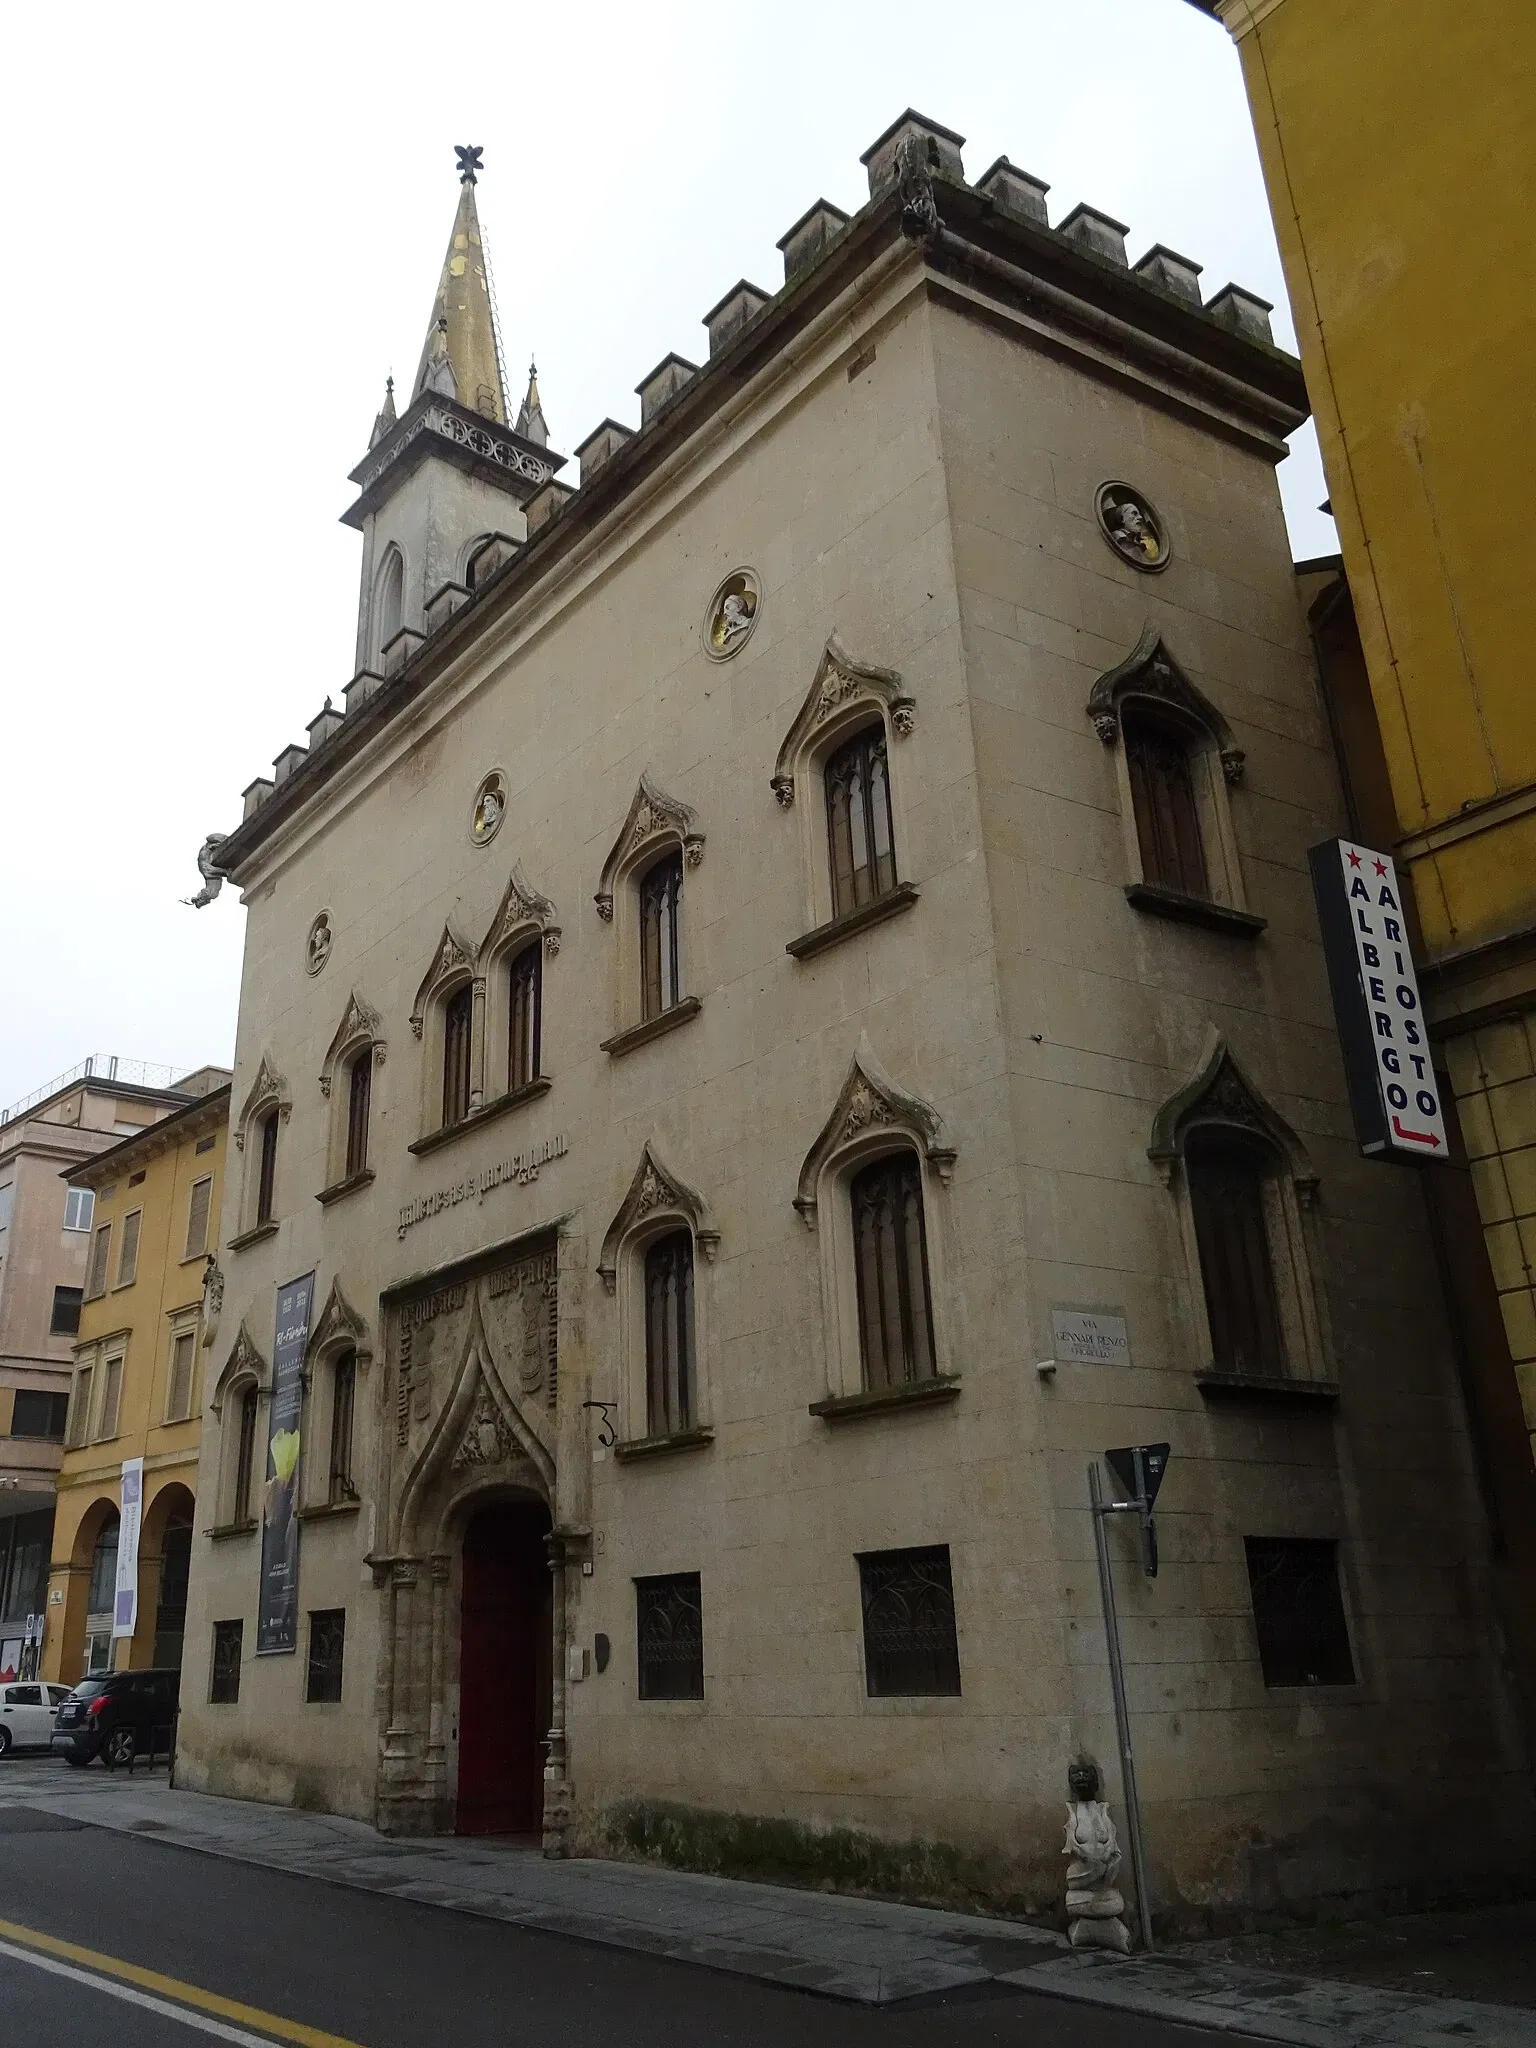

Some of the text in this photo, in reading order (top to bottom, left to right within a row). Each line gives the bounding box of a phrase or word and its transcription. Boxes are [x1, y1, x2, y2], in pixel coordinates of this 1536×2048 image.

[1350, 876, 1407, 1110] ALBERGO
[1378, 885, 1437, 1117] ARIOSTO
[1082, 1319, 1098, 1329] VIA
[1097, 1335, 1126, 1348] RENZO
[597, 1530, 606, 1555] 2
